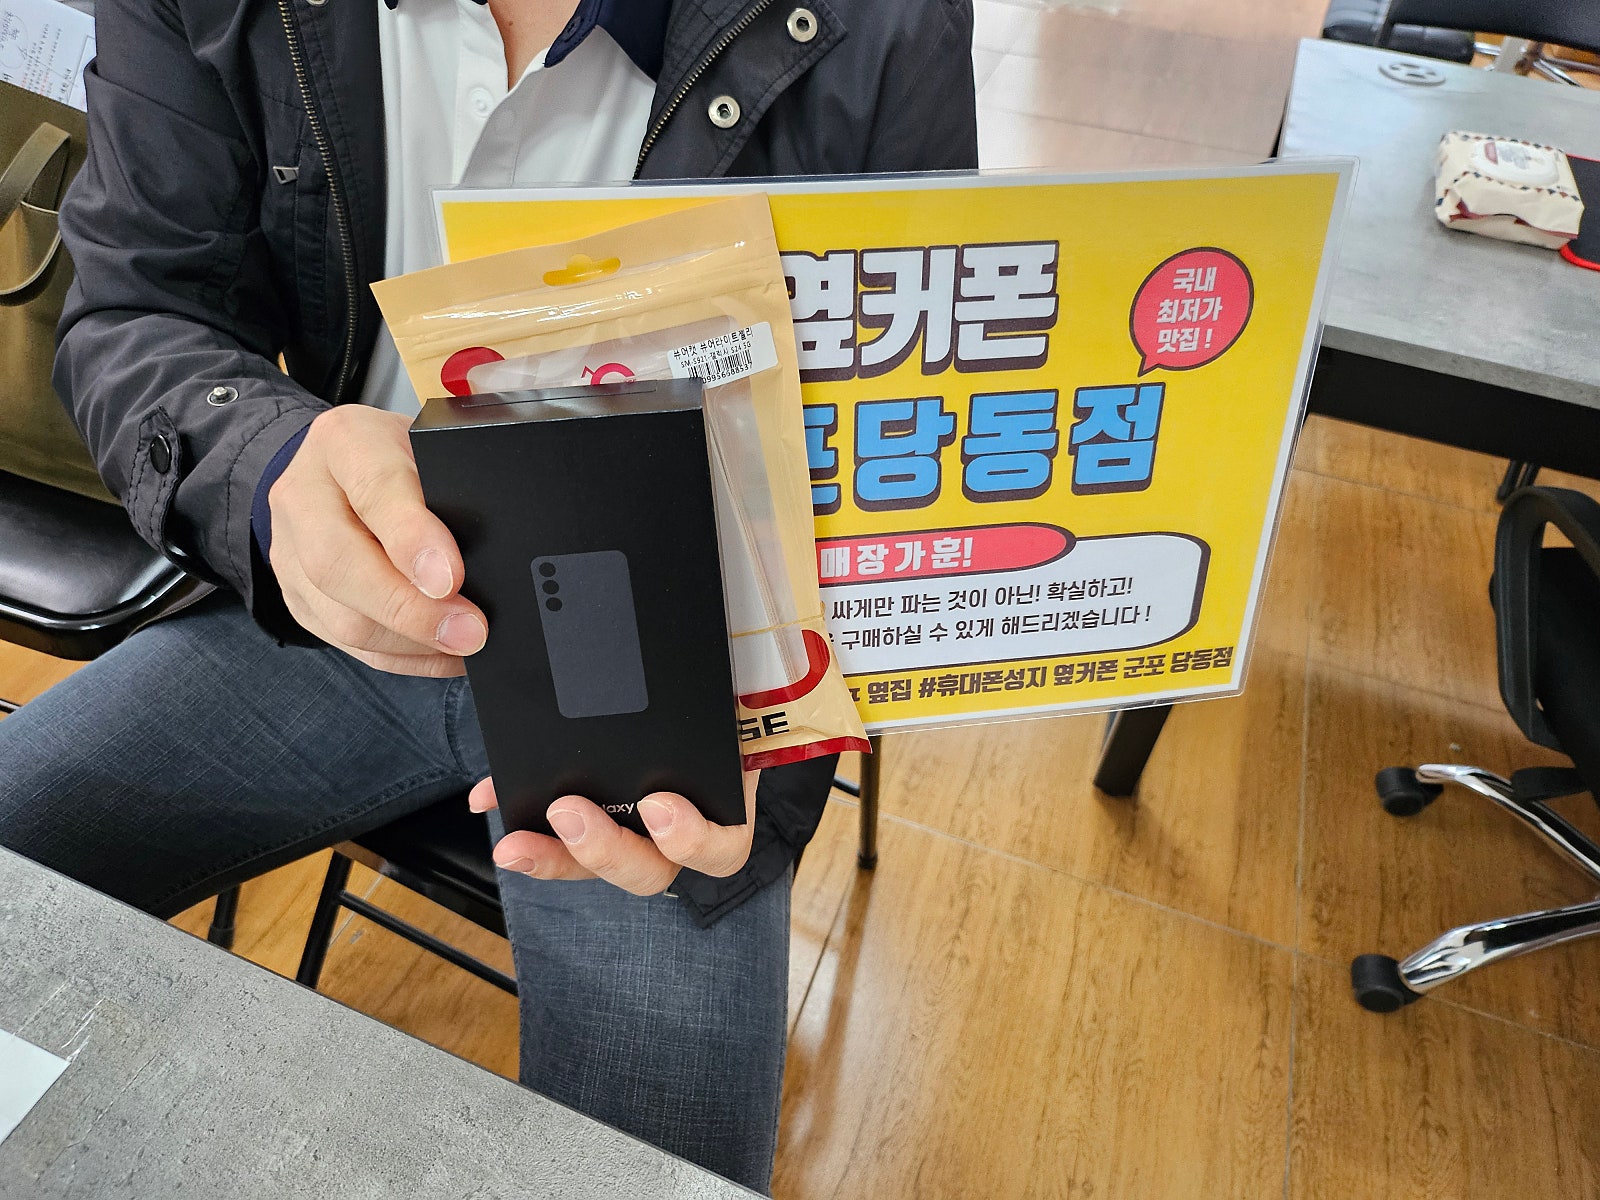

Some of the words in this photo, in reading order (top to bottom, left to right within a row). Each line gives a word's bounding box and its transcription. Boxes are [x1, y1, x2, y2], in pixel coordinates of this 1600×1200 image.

[1173, 267, 1217, 293] 국내
[780, 241, 1059, 382] 옆커폰
[1156, 297, 1223, 324] 최저가
[731, 344, 742, 354] S24
[743, 341, 752, 349] 5G
[831, 596, 895, 620] 싸게만
[900, 593, 942, 615] 파는
[947, 588, 988, 611] 것이
[994, 584, 1041, 606] 아닌!
[1047, 577, 1133, 602] 확실하고!
[841, 624, 922, 651] 구매하실
[929, 622, 948, 643] 수
[955, 617, 995, 641] 있게
[867, 678, 912, 704] 옆집
[918, 666, 1048, 699] #휴대폰성지
[1053, 659, 1119, 686] 옆커폰
[1123, 654, 1167, 679] 군포
[1170, 646, 1234, 673] 당동점
